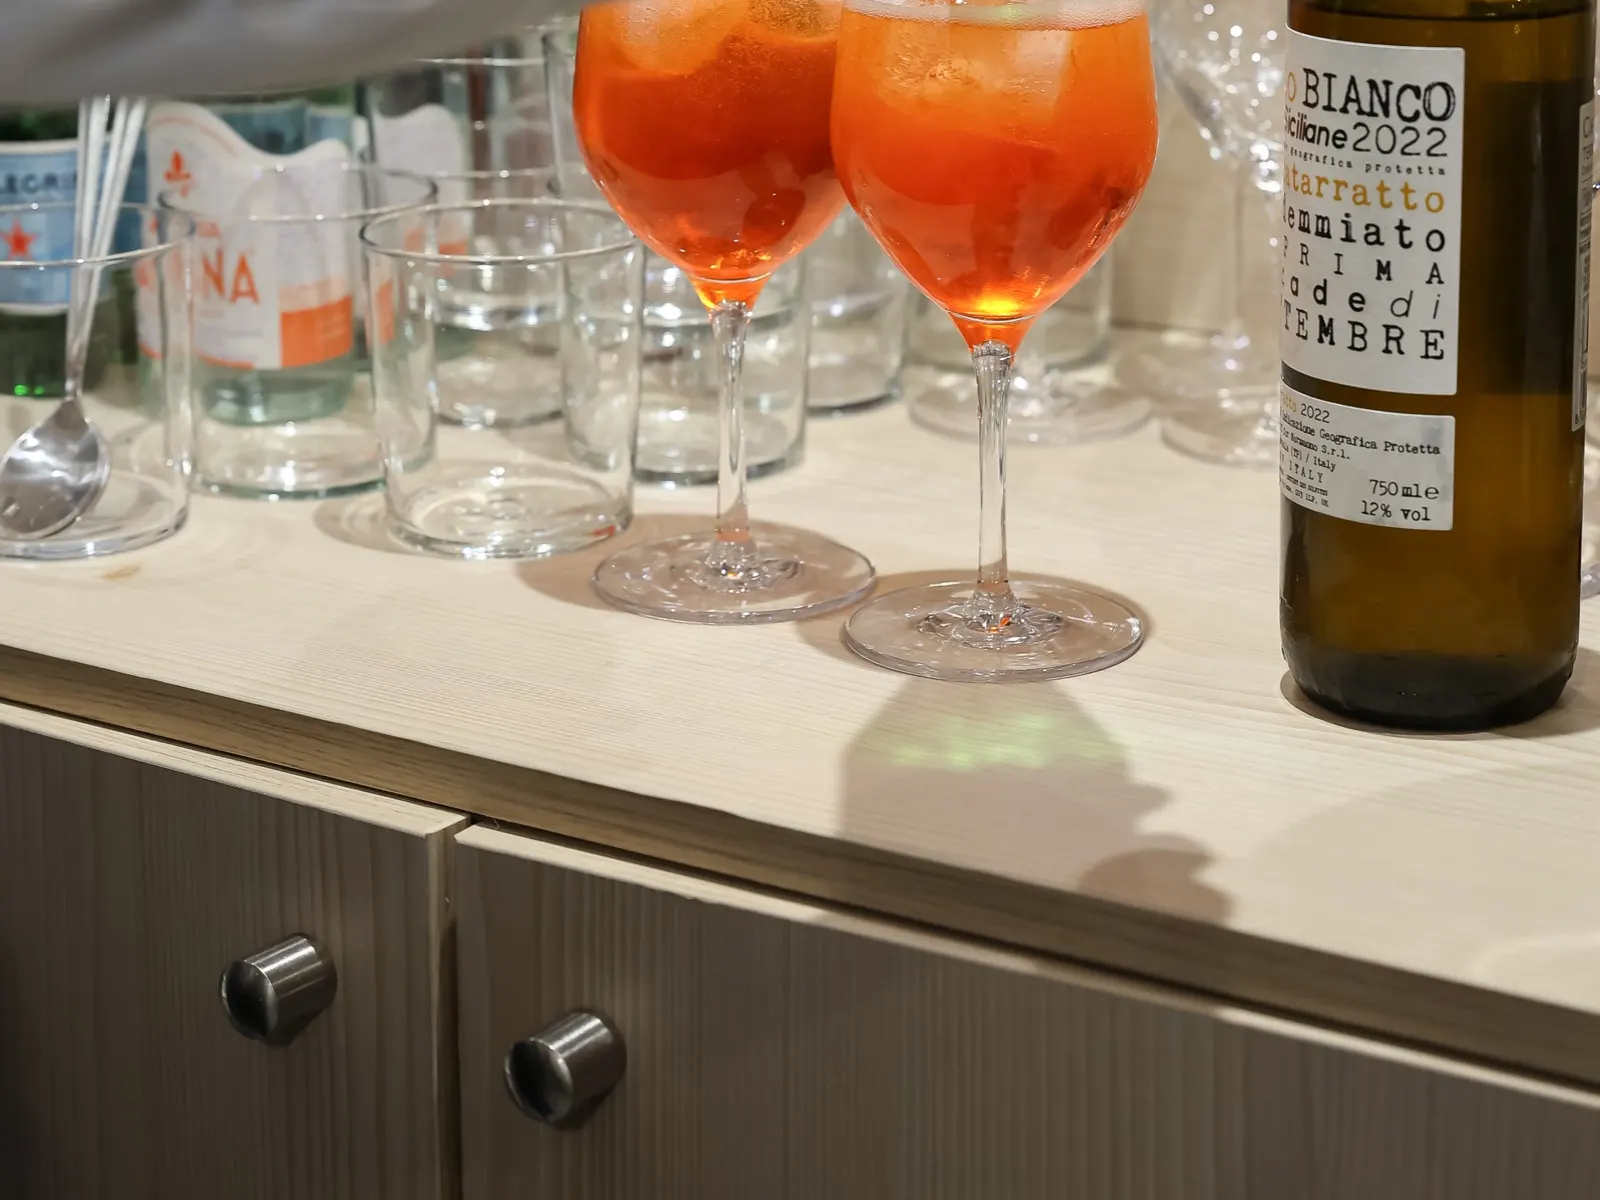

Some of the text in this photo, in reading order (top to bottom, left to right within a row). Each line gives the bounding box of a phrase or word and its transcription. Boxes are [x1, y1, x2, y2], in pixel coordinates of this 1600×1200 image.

[1302, 67, 1456, 123] BIANCO
[1352, 122, 1447, 157] 2022
[1290, 146, 1446, 176] geografica protetta
[1300, 403, 1331, 424] 2022
[1320, 429, 1378, 450] Geografica
[1383, 441, 1440, 455] Protetta
[1321, 444, 1350, 460] S.r.l.
[1289, 461, 1323, 484] ITALY
[1313, 456, 1336, 472] Italy
[1361, 500, 1432, 522] 12% vol
